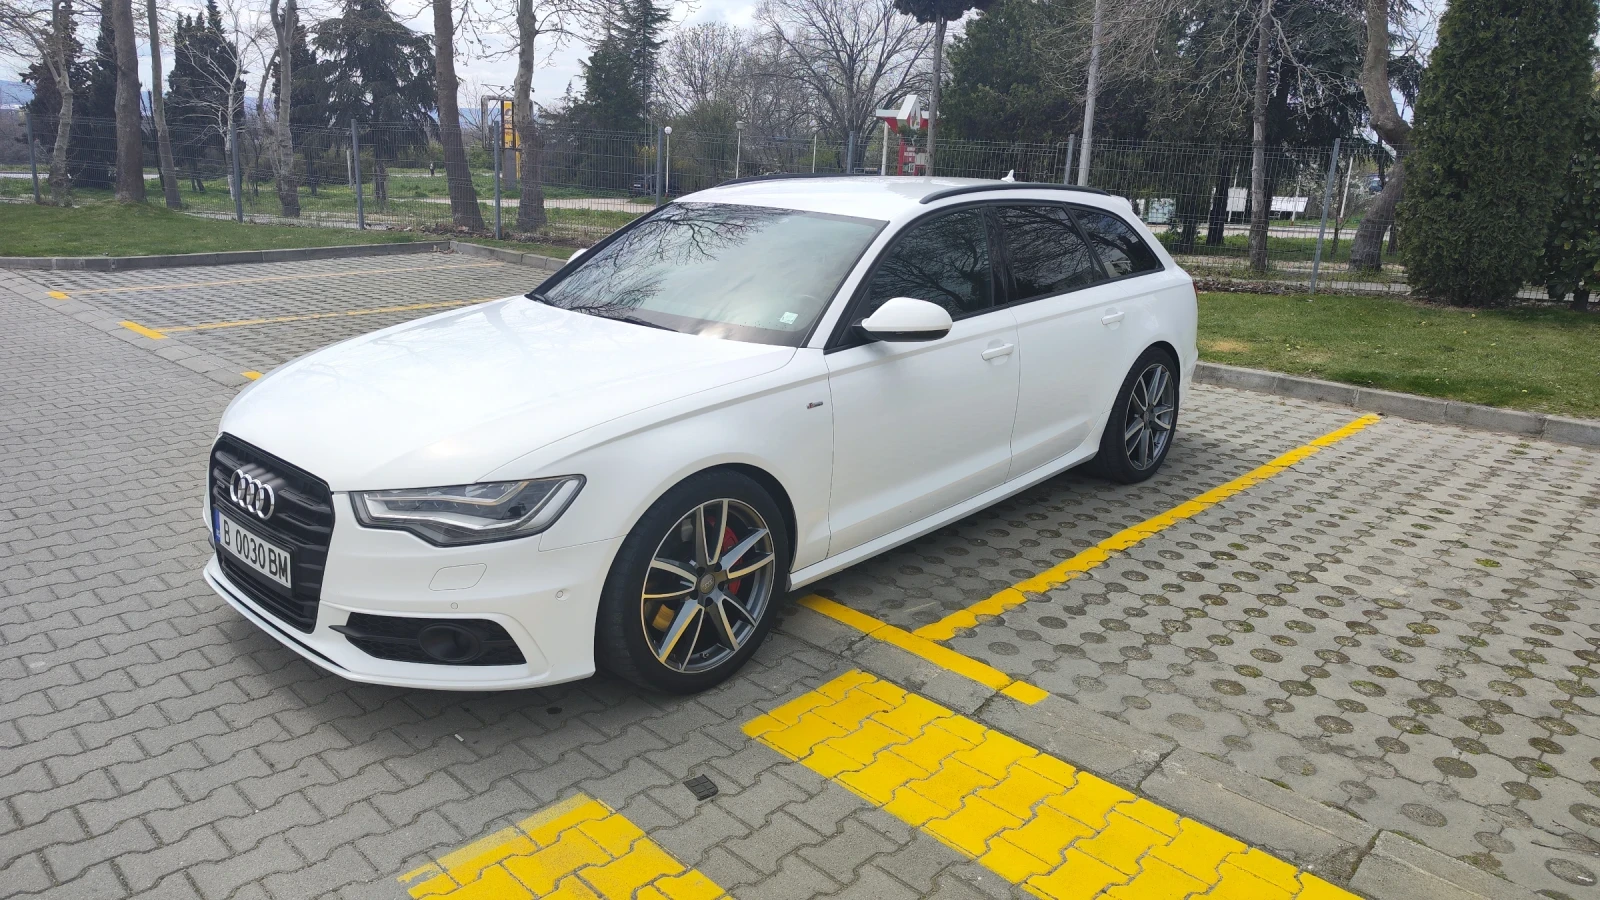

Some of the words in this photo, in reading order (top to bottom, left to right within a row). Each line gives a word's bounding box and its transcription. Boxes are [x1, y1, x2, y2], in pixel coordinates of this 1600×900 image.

[223, 519, 230, 547] B
[235, 529, 266, 570] 0030
[268, 547, 289, 584] BM
